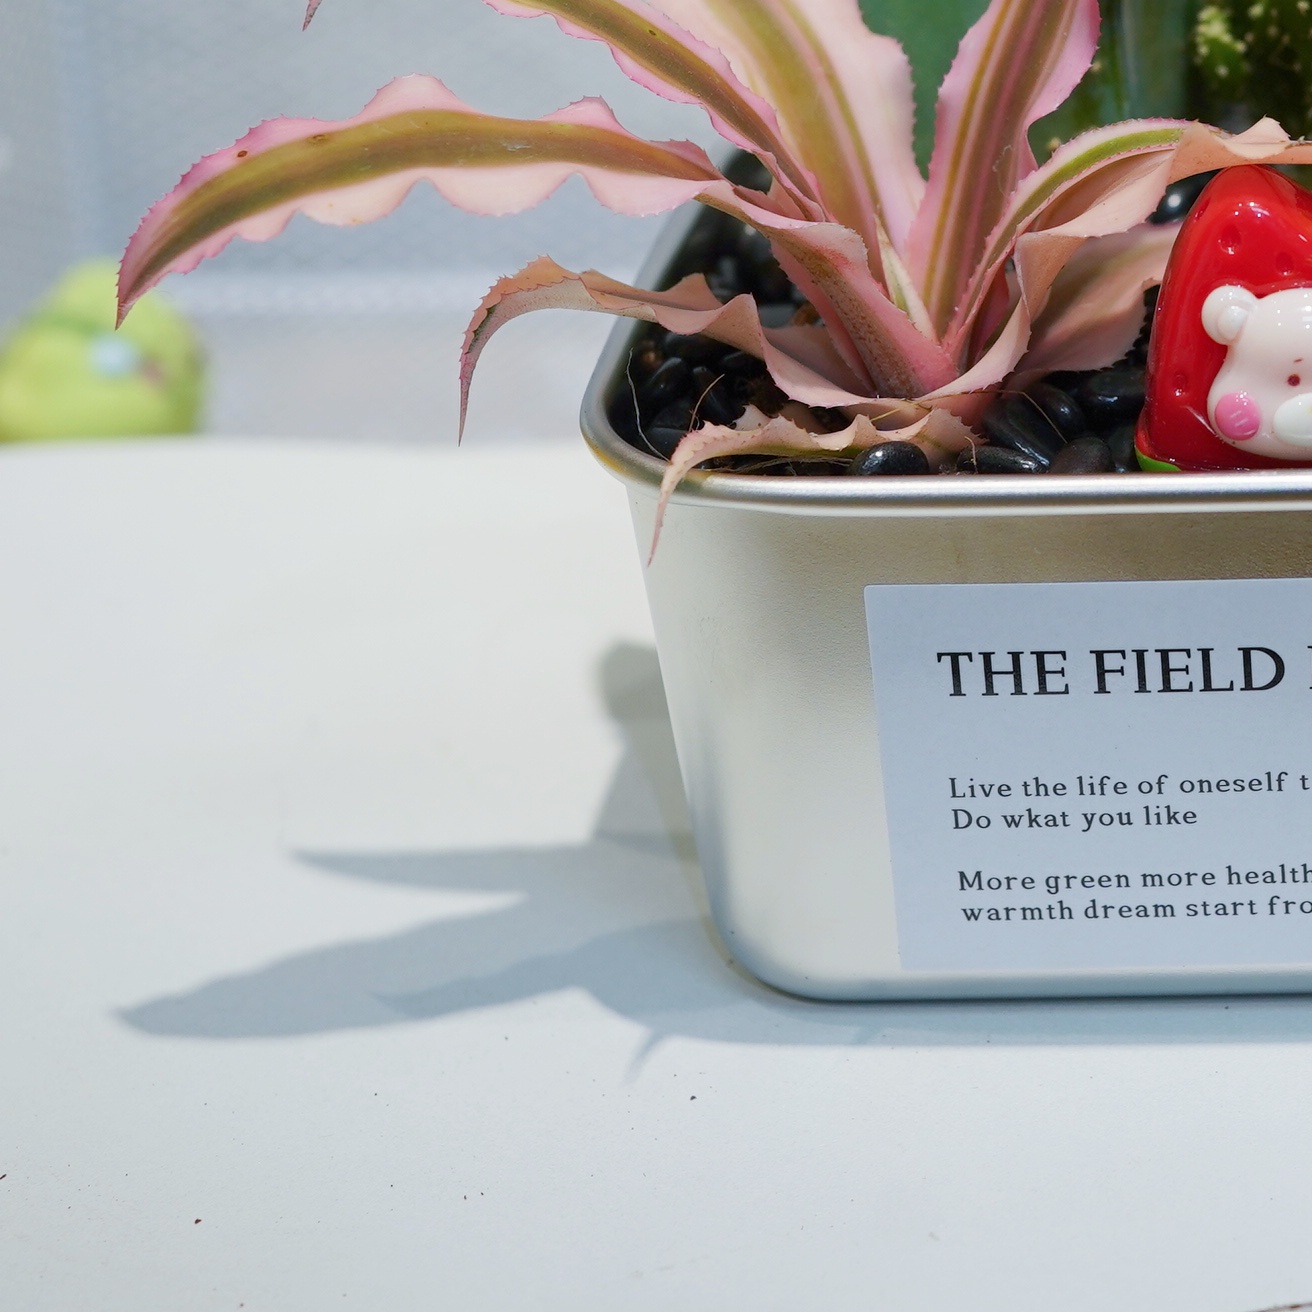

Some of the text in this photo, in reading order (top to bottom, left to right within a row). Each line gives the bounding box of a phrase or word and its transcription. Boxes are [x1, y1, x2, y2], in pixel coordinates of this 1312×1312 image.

[936, 650, 1070, 697] THE
[1089, 646, 1286, 695] FIELD
[948, 777, 1012, 799] Live
[1021, 776, 1068, 797] the
[1076, 775, 1128, 797] life
[1137, 774, 1169, 795] of
[1179, 771, 1289, 794] oneself
[951, 808, 992, 830] Do
[1081, 811, 1134, 833] you
[1142, 804, 1198, 826] like
[957, 870, 1036, 892] More
[1044, 873, 1131, 895] green
[1140, 871, 1216, 888] more
[960, 899, 1075, 922] warmth
[1083, 898, 1176, 920] dream
[1185, 899, 1258, 917] start
